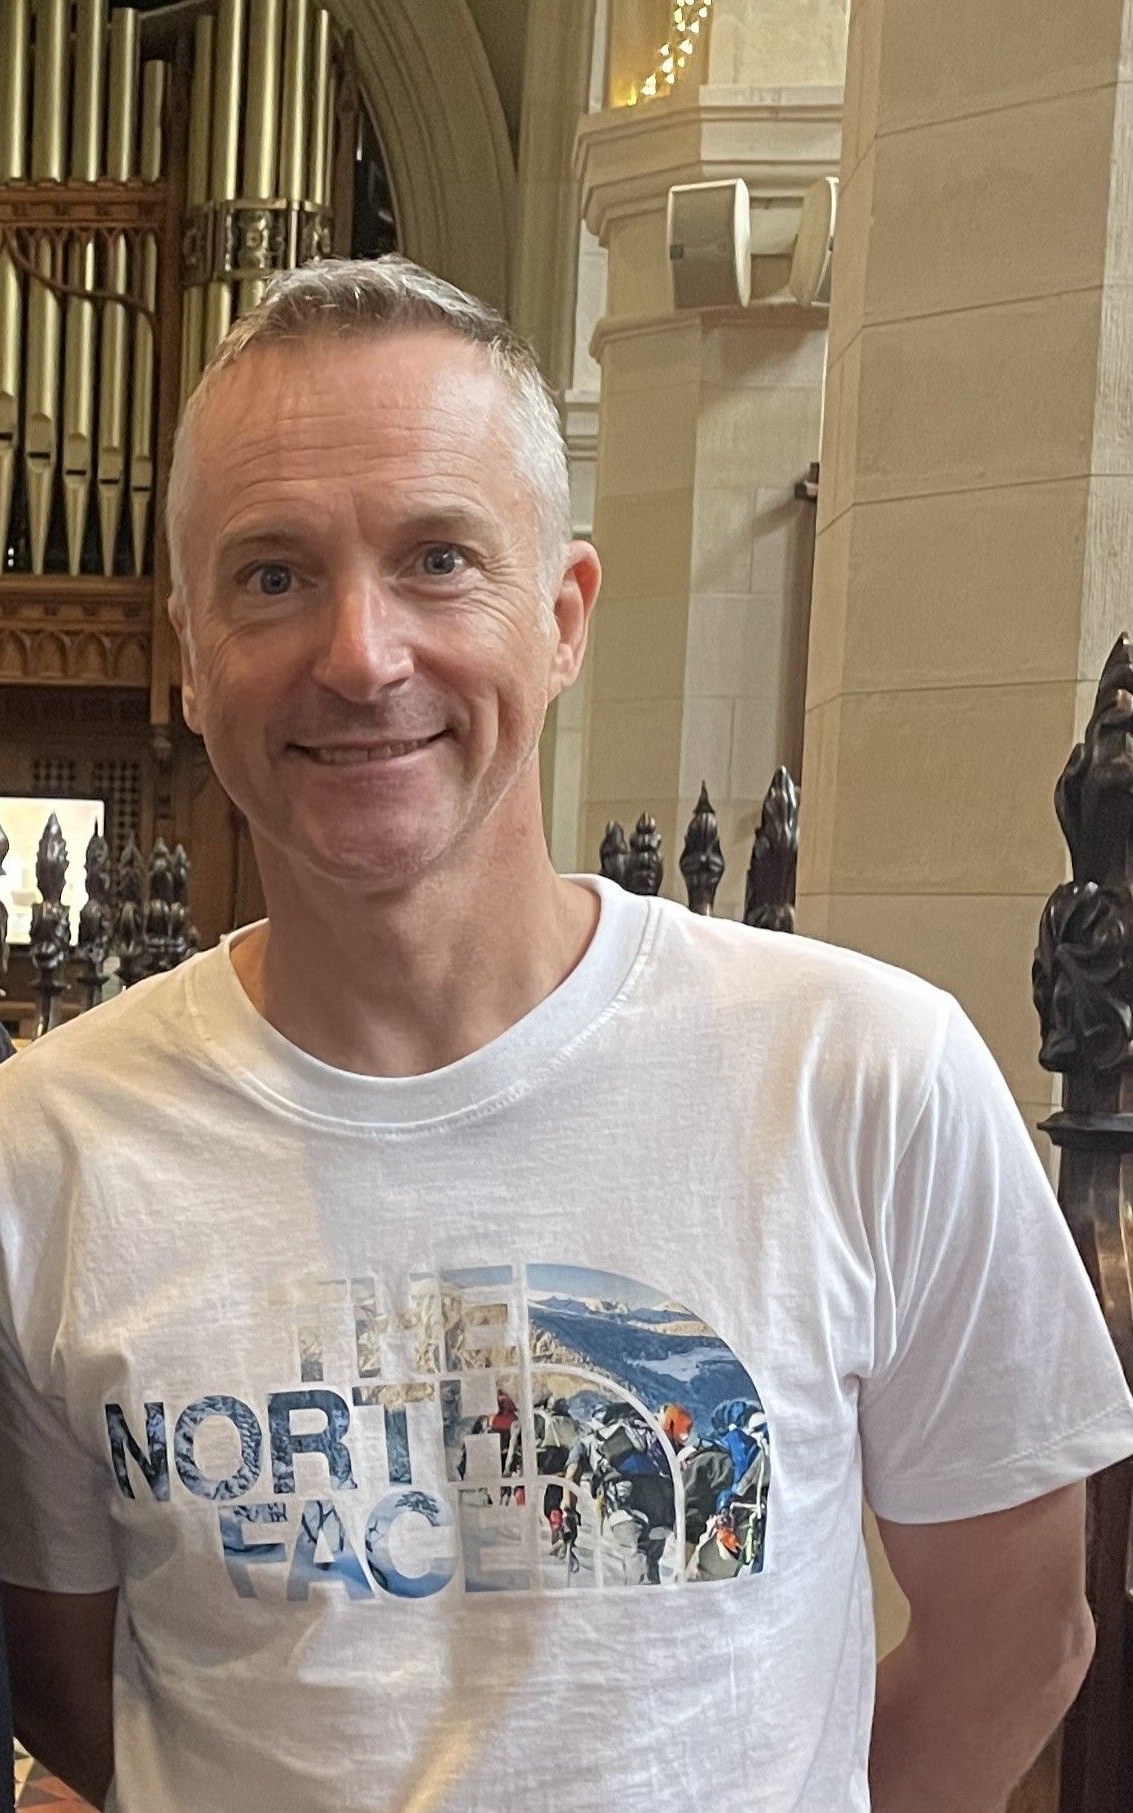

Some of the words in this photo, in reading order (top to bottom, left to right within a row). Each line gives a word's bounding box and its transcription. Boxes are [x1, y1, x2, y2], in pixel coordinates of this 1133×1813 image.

[271, 1264, 518, 1382] THE
[105, 1378, 524, 1502] NORTH
[219, 1486, 531, 1600] FACE
